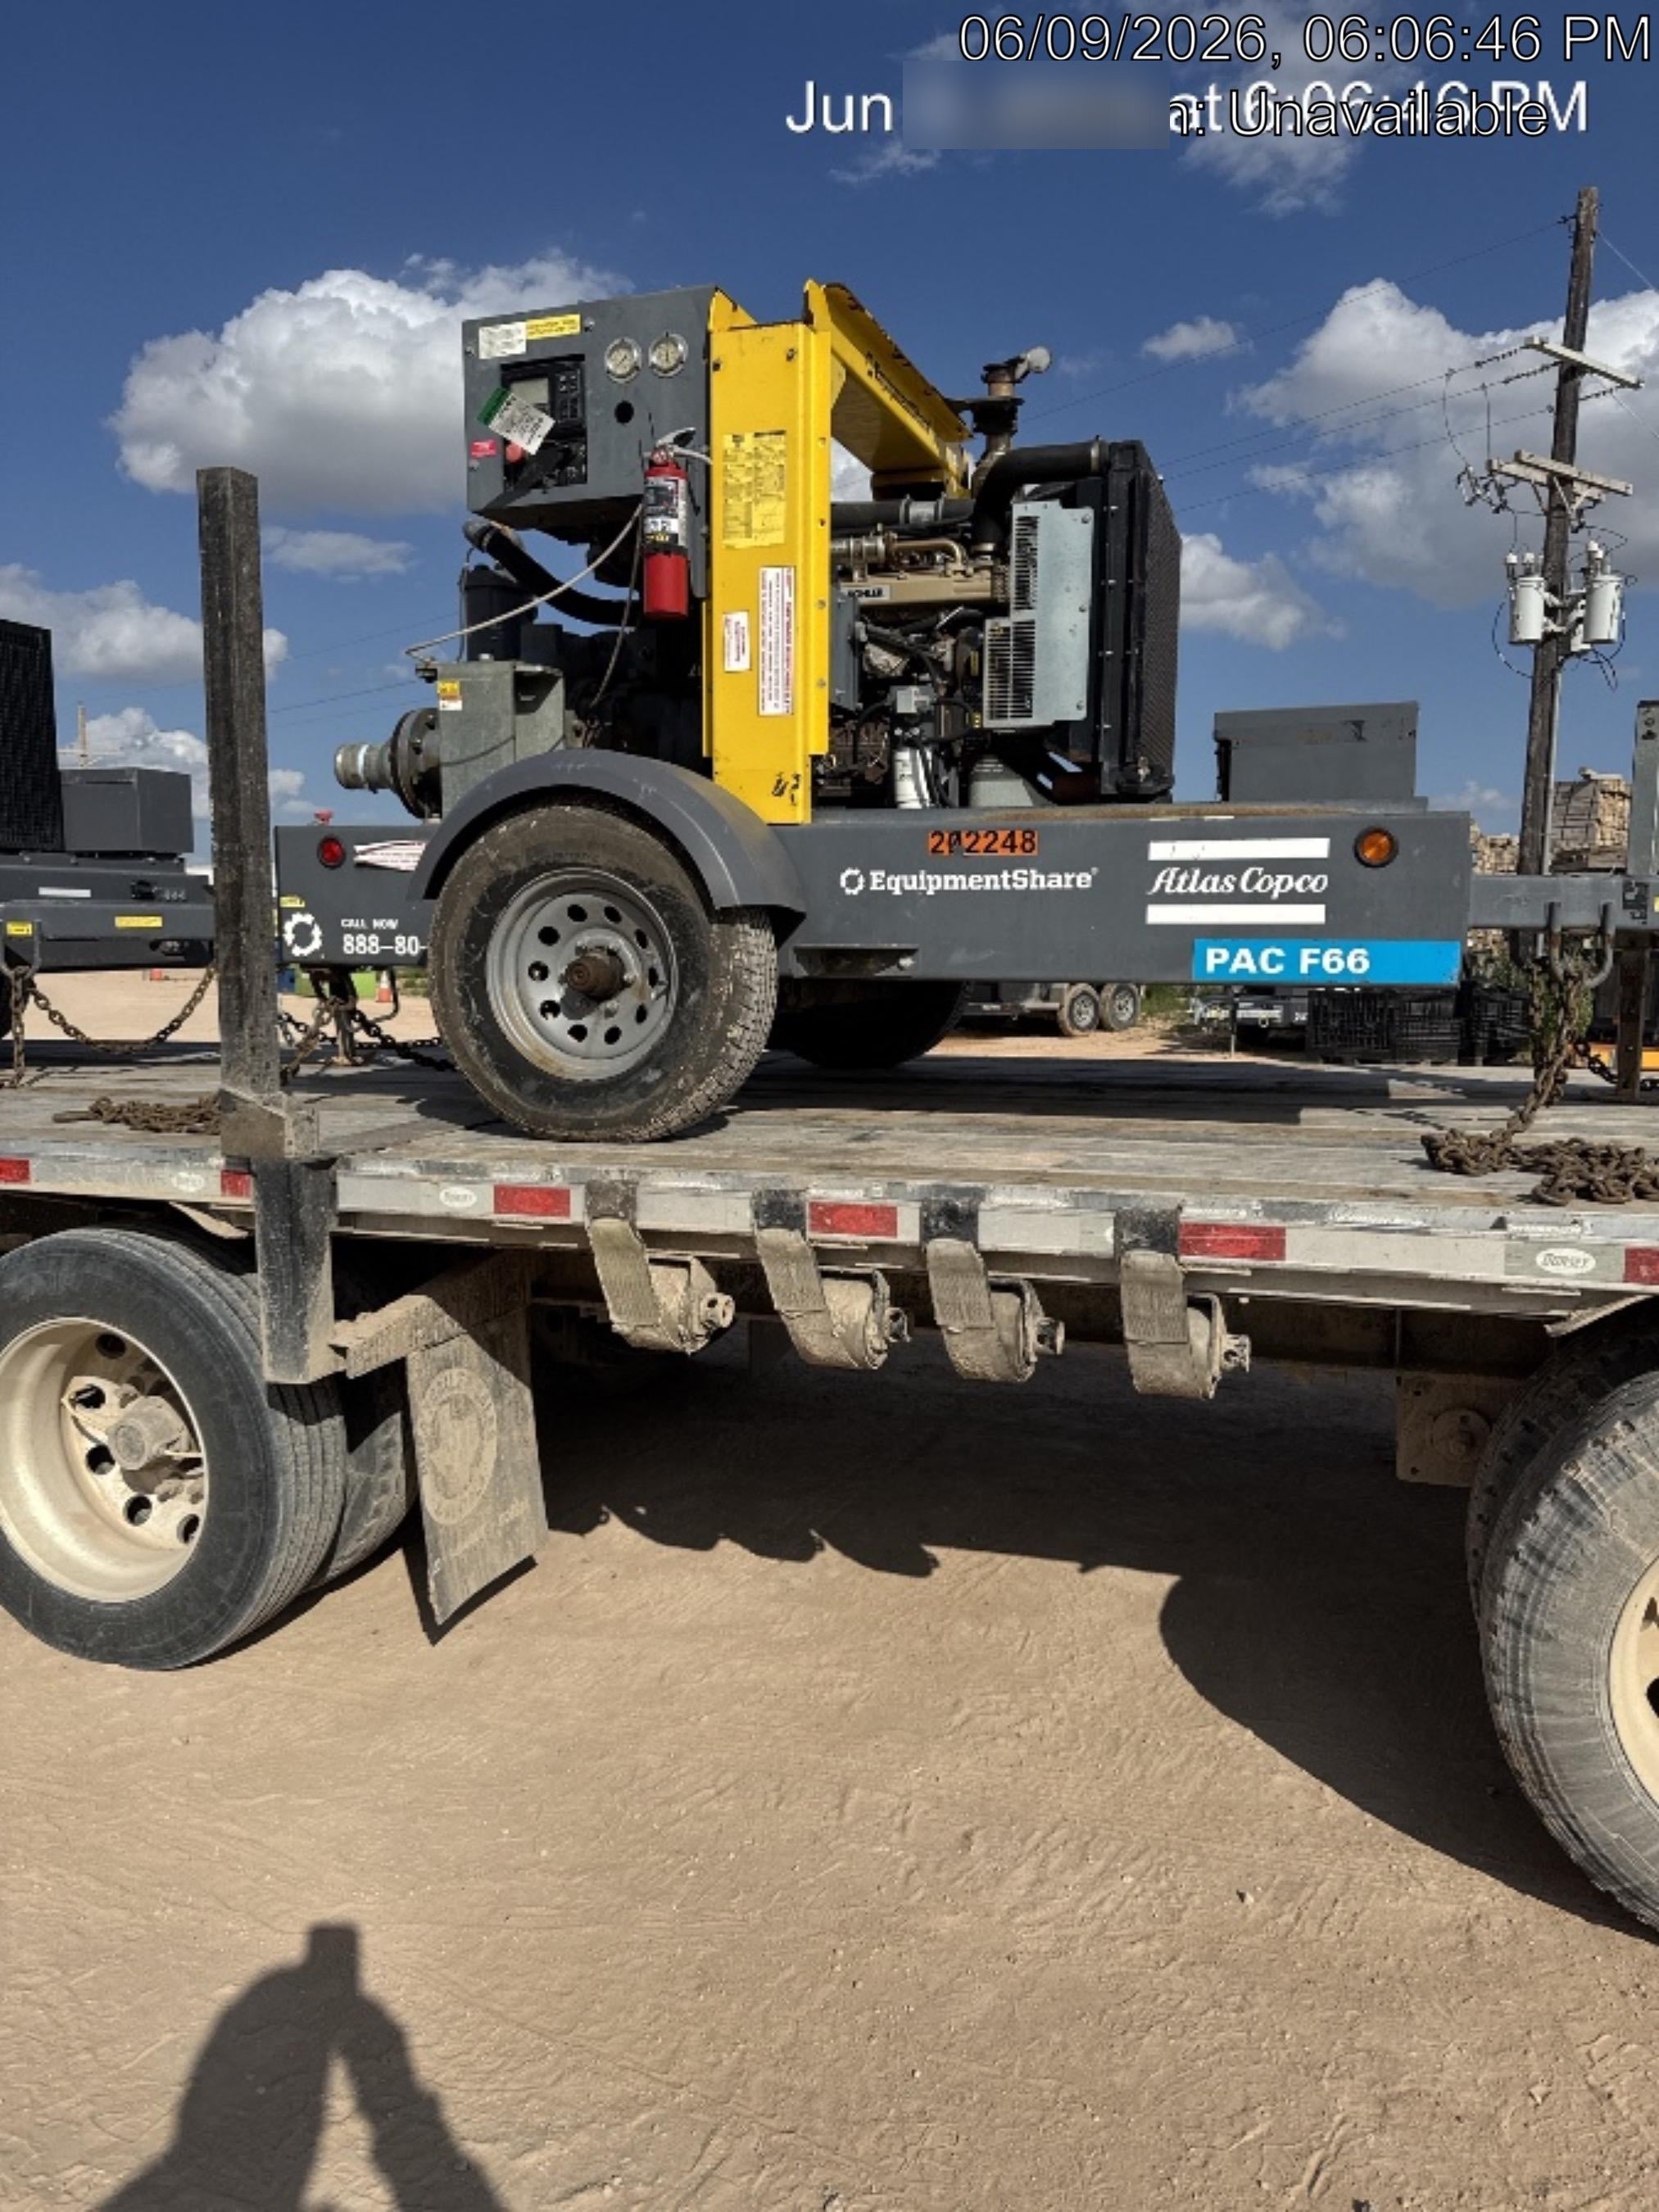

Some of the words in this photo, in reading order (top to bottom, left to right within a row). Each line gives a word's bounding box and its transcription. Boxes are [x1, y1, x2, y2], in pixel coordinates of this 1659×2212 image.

[1147, 867, 1237, 895] Atlas
[1240, 867, 1329, 900] Copco
[341, 918, 368, 930] CALL
[373, 918, 399, 930] NOW
[1205, 947, 1286, 975] PAC
[1299, 947, 1371, 975] F66
